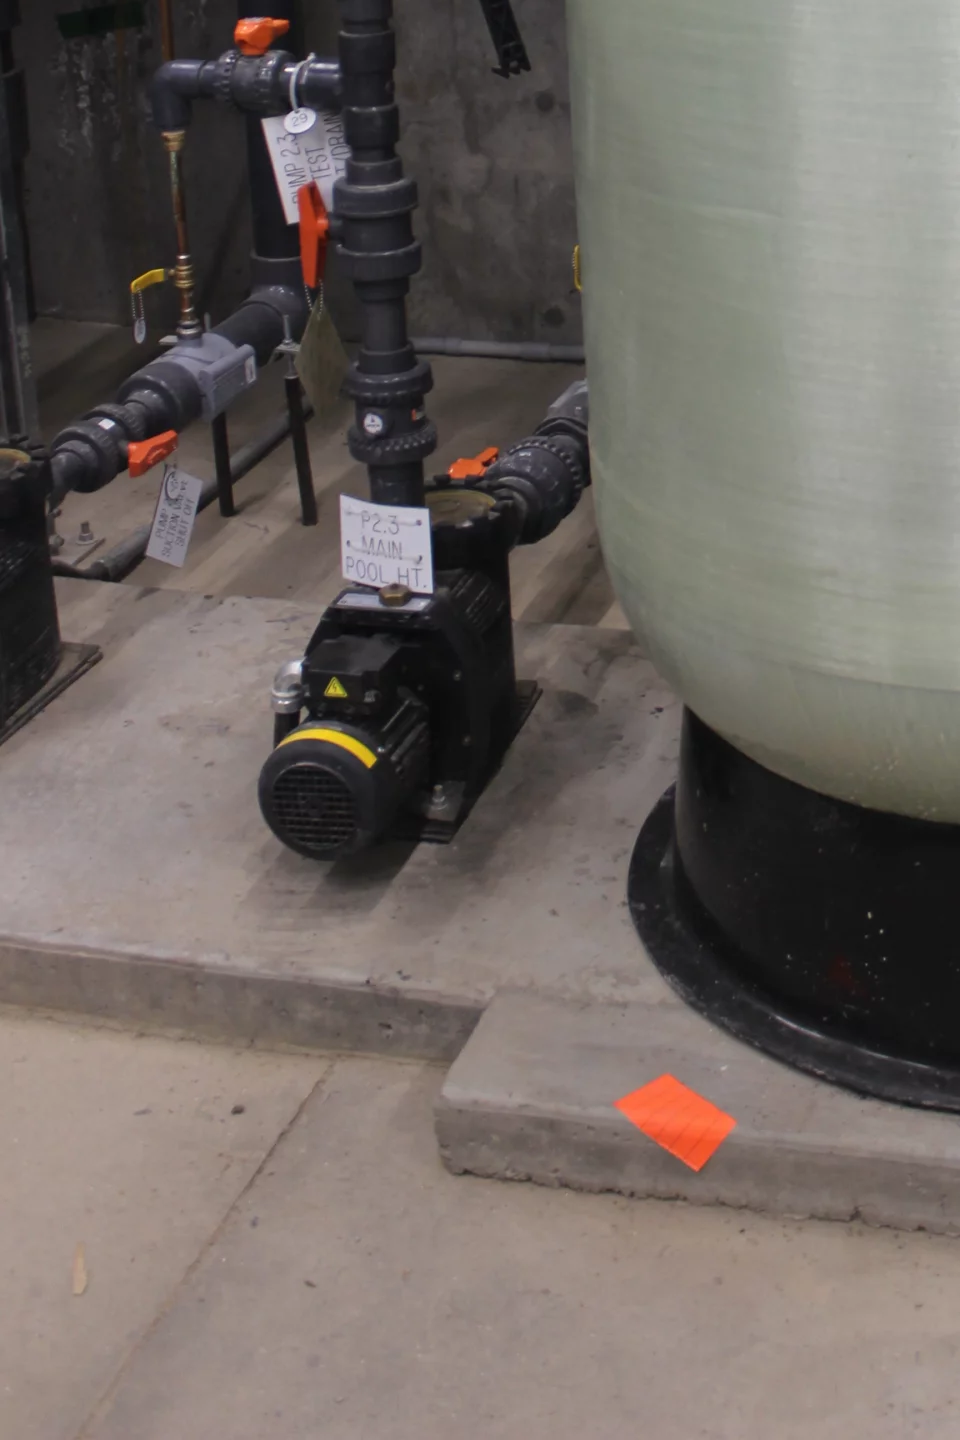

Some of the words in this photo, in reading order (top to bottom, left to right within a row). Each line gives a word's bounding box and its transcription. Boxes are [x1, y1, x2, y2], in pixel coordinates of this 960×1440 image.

[291, 112, 309, 127] 29
[276, 133, 302, 158] 2.3
[304, 147, 332, 182] TEST
[361, 510, 400, 536] P2.3
[361, 535, 403, 560] MAIN
[345, 555, 390, 585] POOL
[397, 566, 428, 589] HT.
